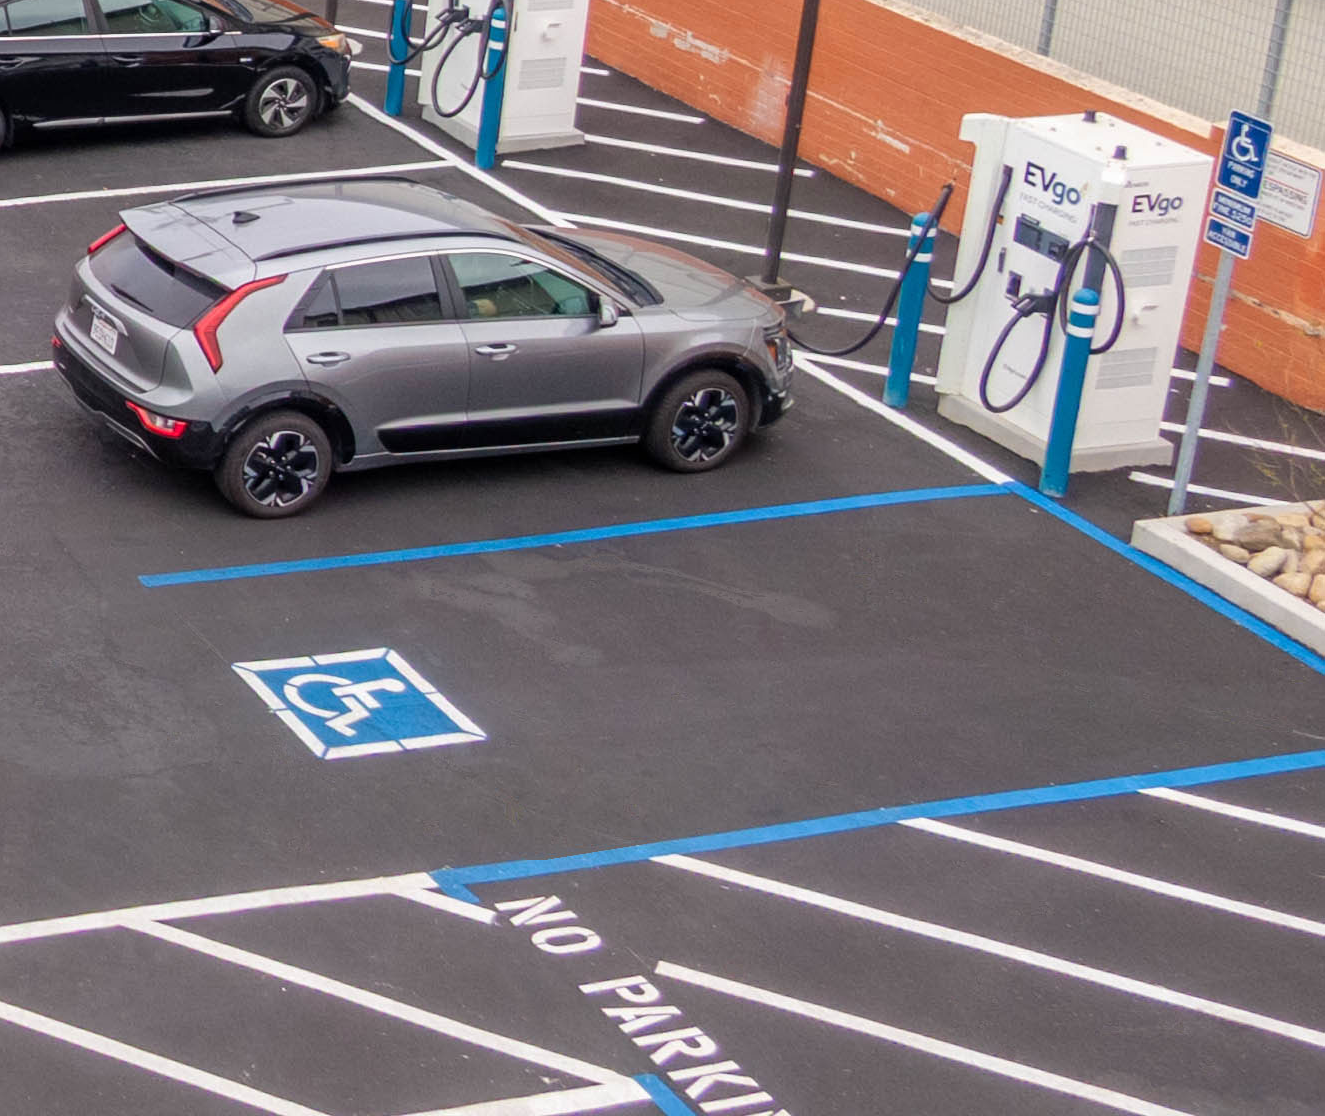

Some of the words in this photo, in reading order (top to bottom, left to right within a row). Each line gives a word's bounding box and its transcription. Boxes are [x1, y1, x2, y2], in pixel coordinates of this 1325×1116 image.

[1024, 161, 1081, 205] EVgo
[1131, 194, 1183, 216] EVgo
[494, 895, 602, 954] NO
